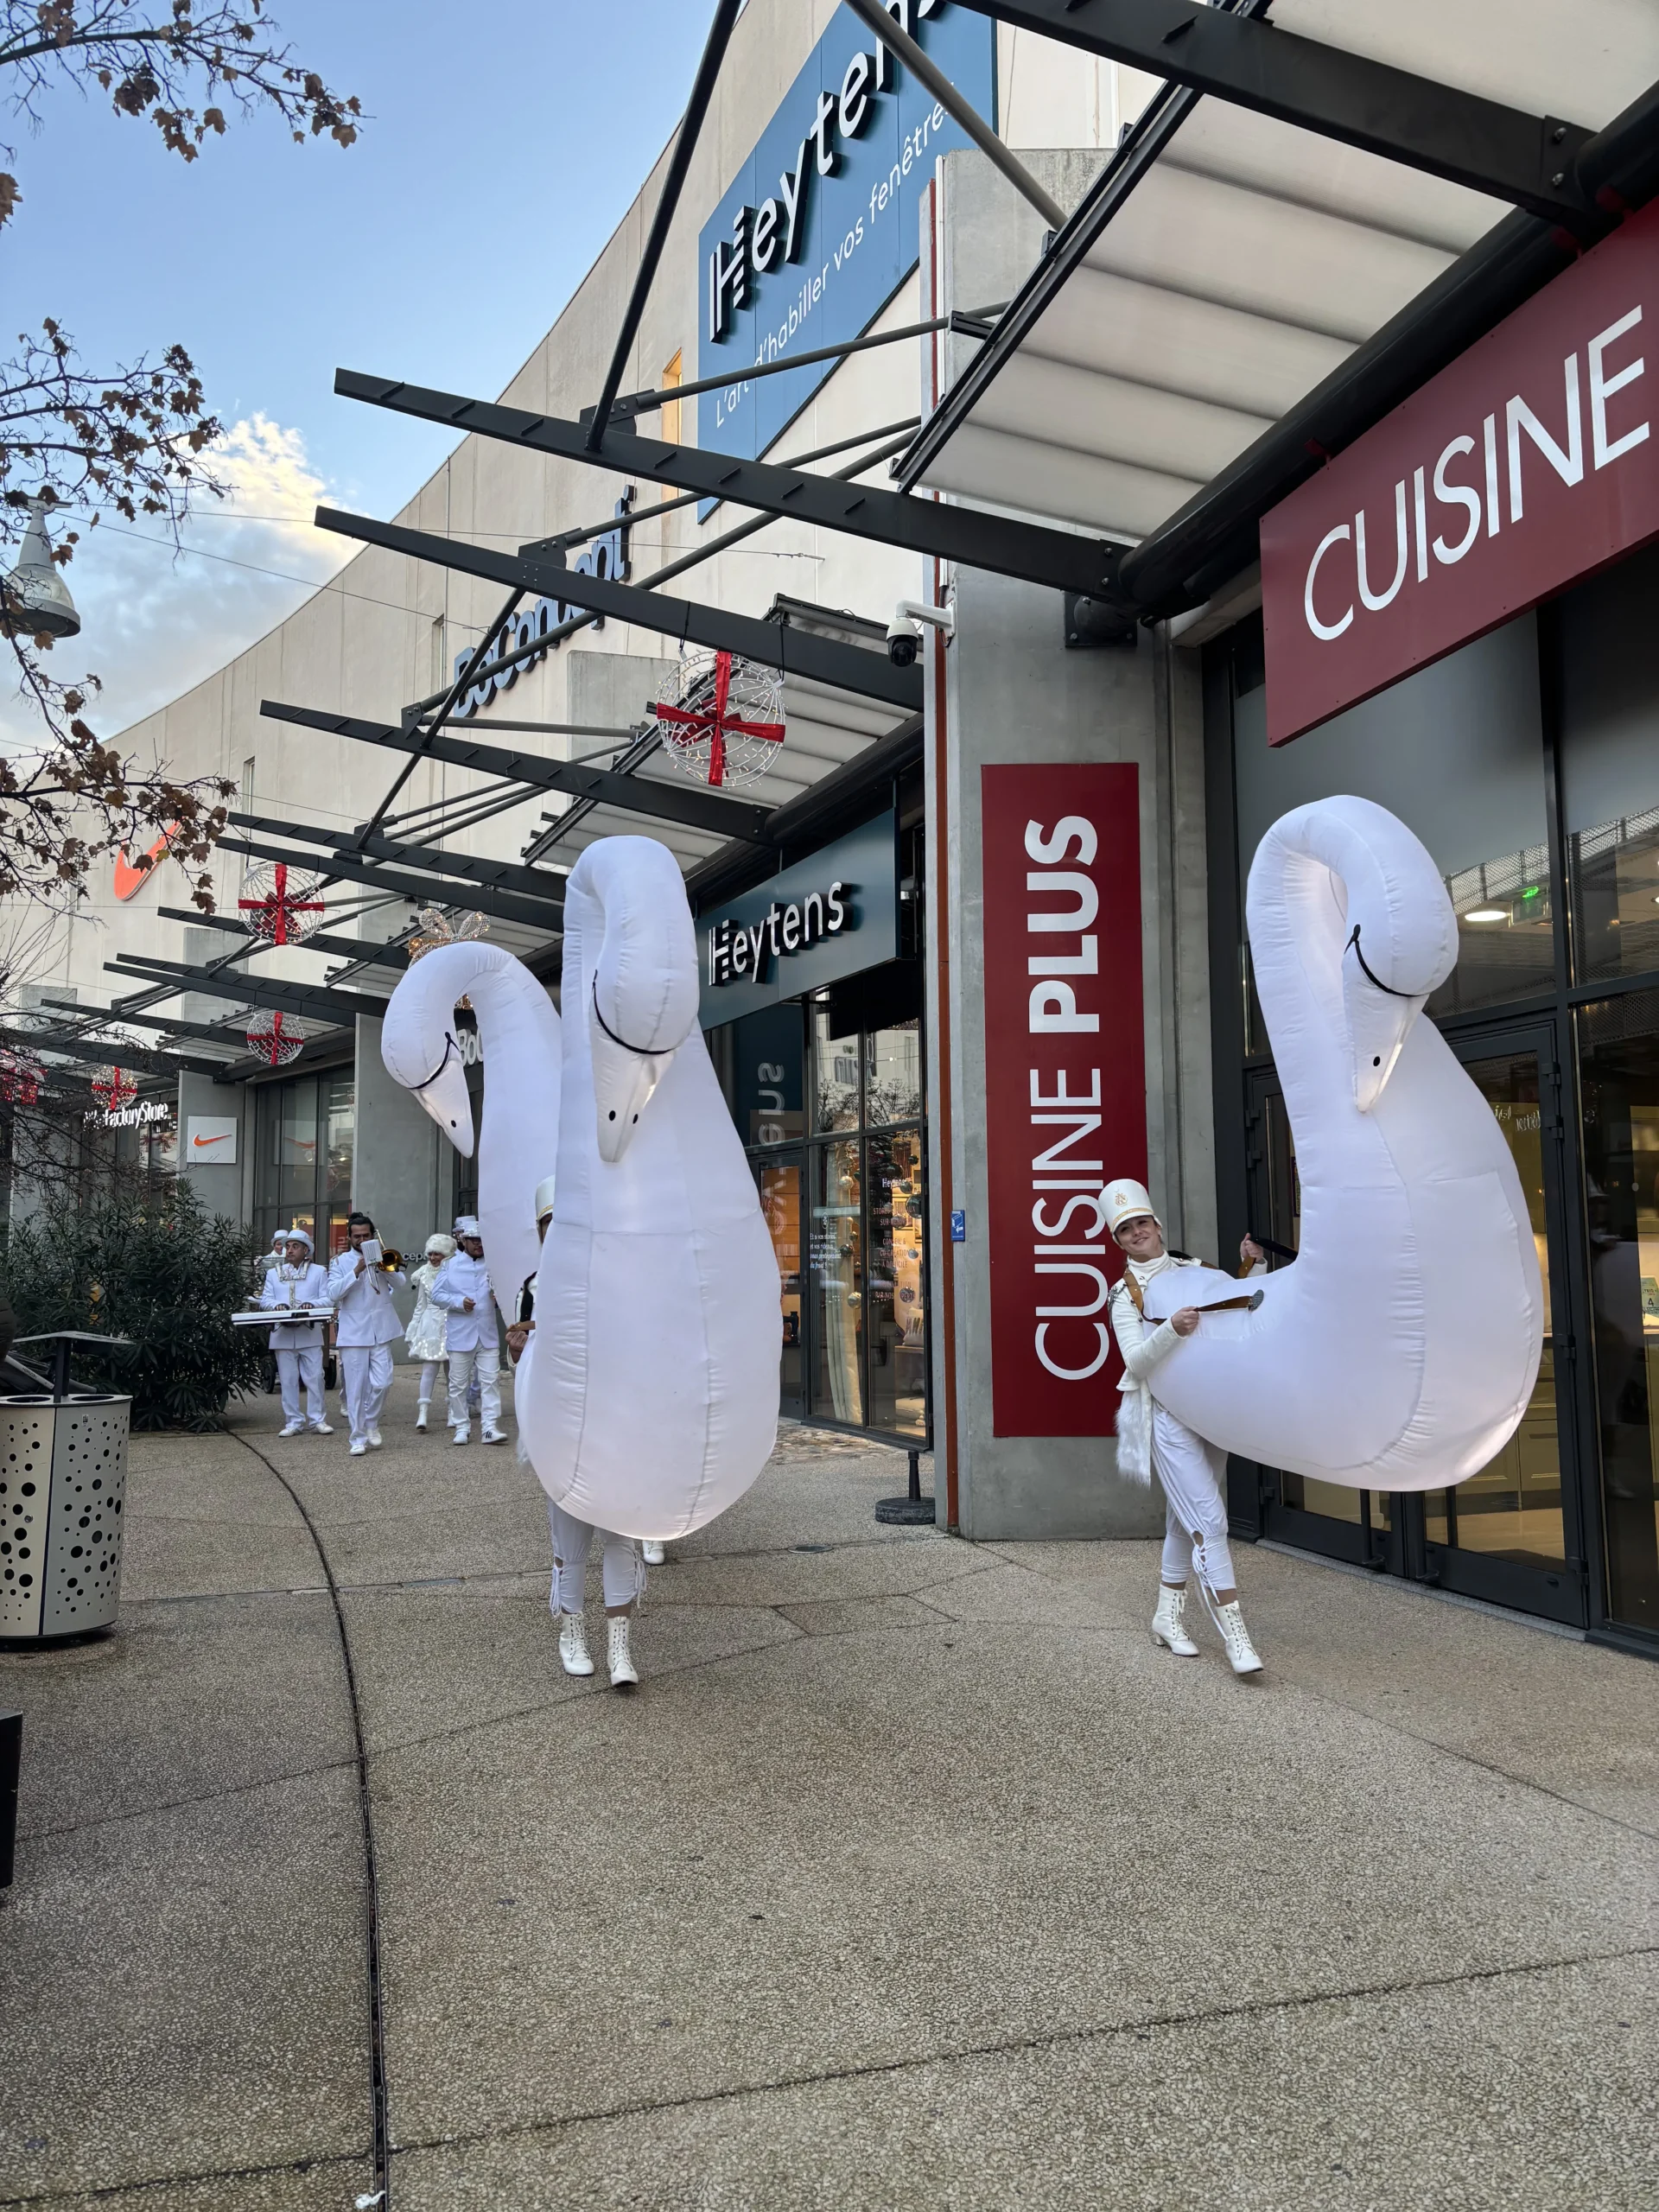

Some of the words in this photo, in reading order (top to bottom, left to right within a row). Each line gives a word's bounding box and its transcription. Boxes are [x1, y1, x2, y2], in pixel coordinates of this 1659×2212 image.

[709, 0, 940, 342] Heyten
[833, 216, 864, 271] vos
[868, 81, 954, 225] fenêtre
[1304, 304, 1650, 641] CUISINE
[709, 880, 844, 987] Heytens
[1024, 815, 1101, 1033] PLUS
[1029, 1067, 1110, 1381] CUISINE
